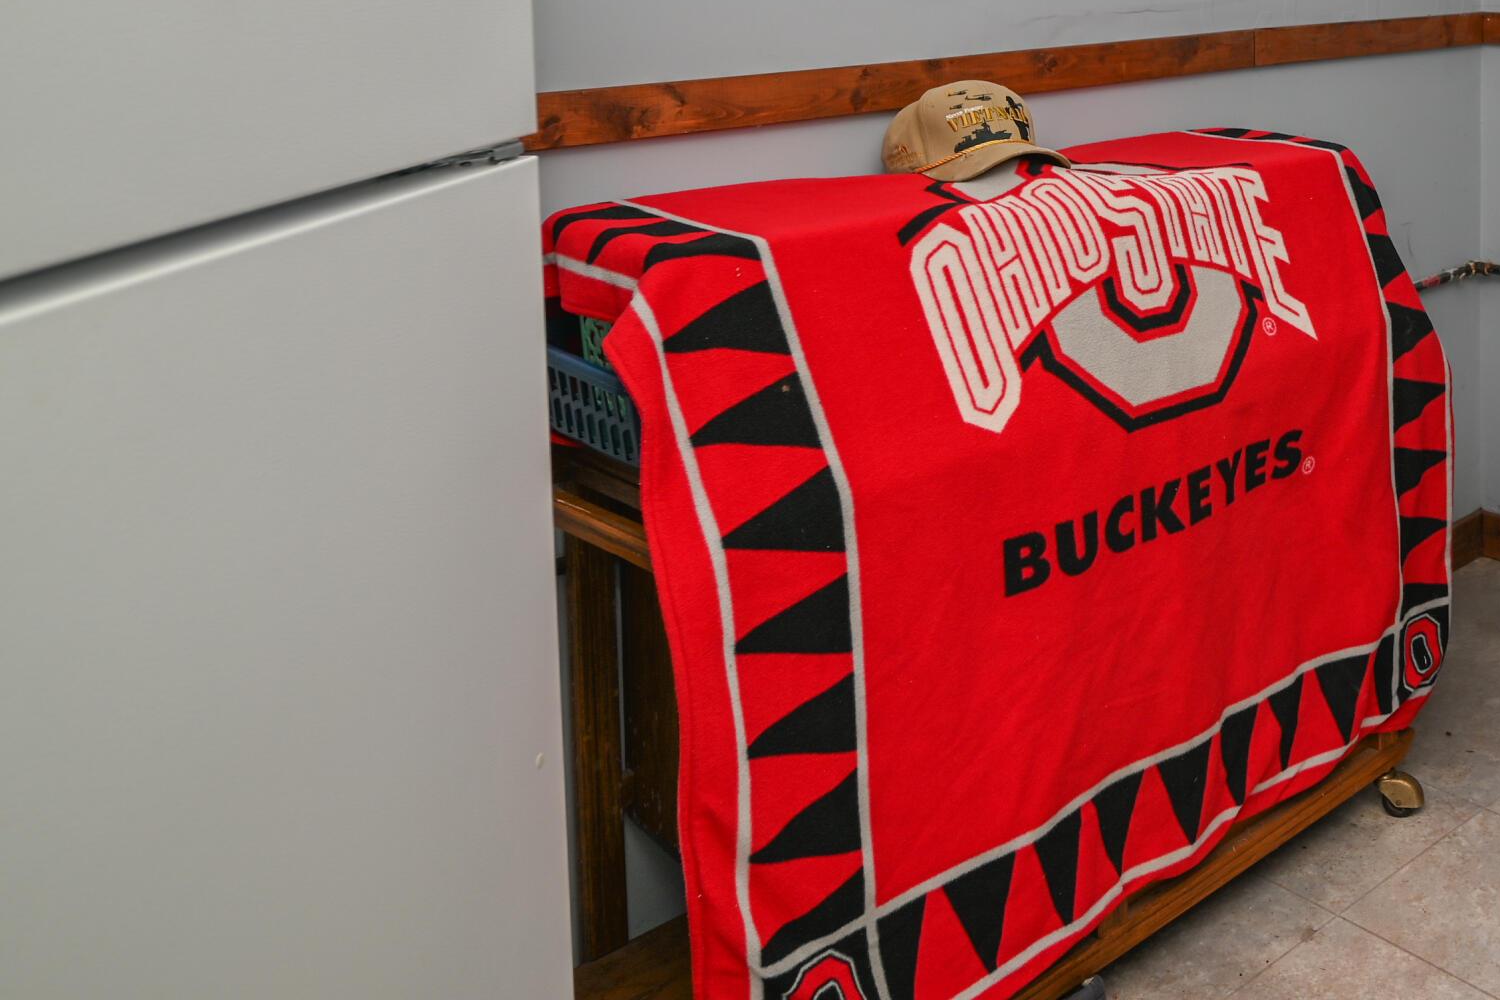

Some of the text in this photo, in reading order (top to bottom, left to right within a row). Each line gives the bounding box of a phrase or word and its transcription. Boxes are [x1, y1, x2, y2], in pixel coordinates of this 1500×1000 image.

[910, 166, 1319, 434] OHIO STATE
[1002, 429, 1304, 598] BUCKEYES
